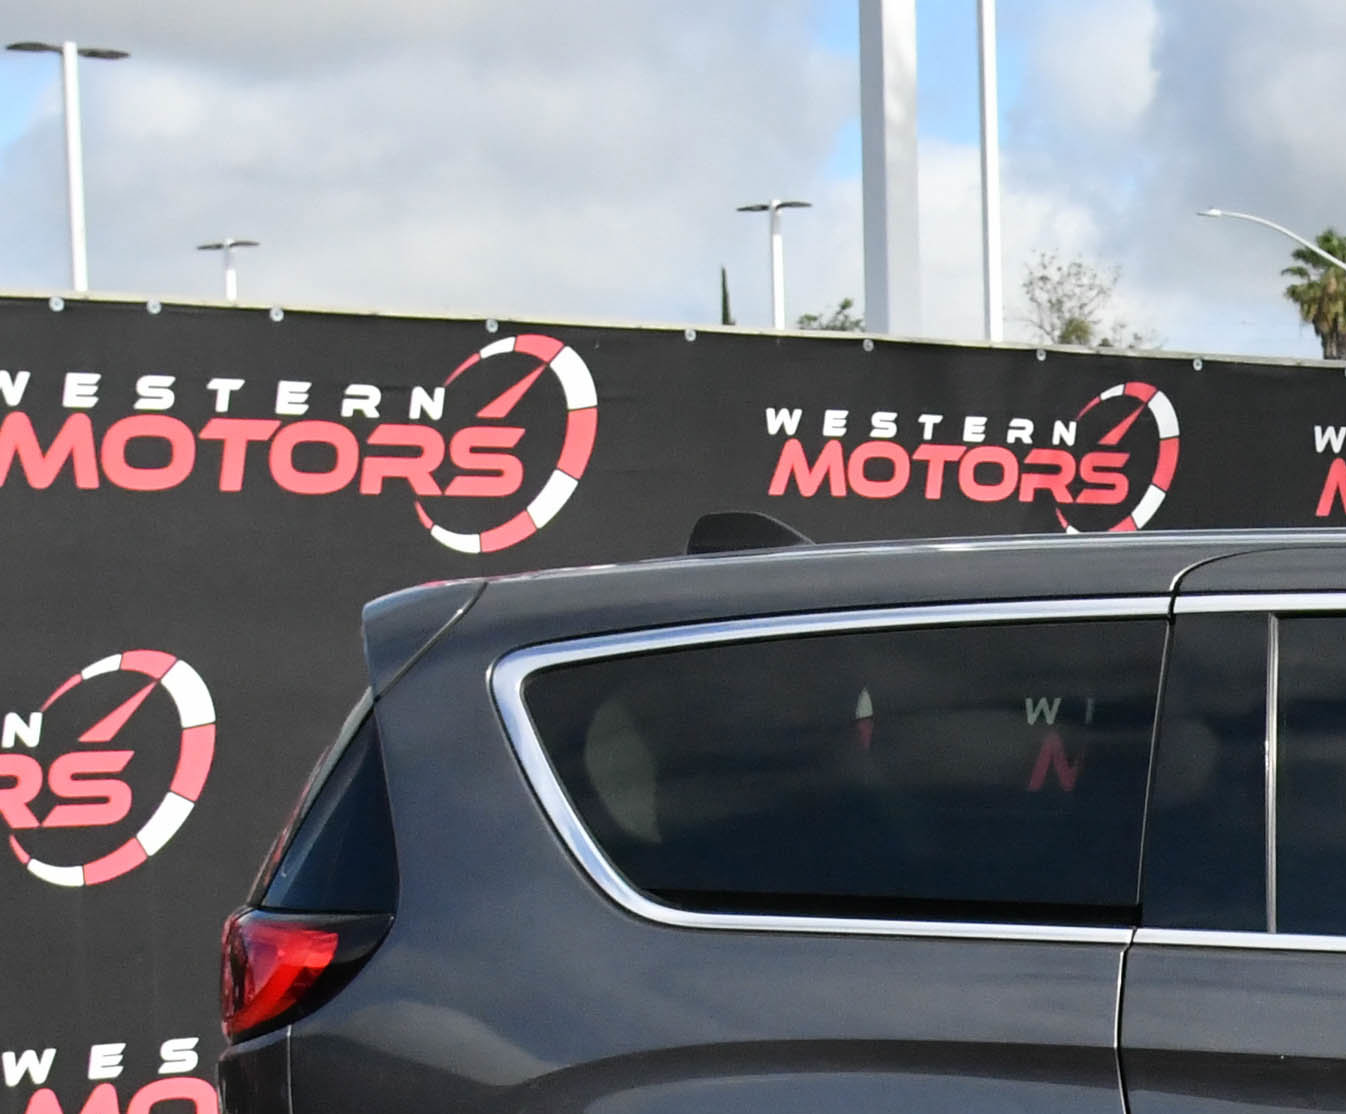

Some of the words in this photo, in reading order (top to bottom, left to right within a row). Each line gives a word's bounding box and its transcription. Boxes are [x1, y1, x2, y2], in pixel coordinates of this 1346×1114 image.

[766, 408, 1077, 446] WESTERN
[0, 411, 525, 496] MOTORS
[768, 438, 1130, 504] MOTORS
[1, 711, 43, 749] N
[2, 1037, 199, 1087] WES
